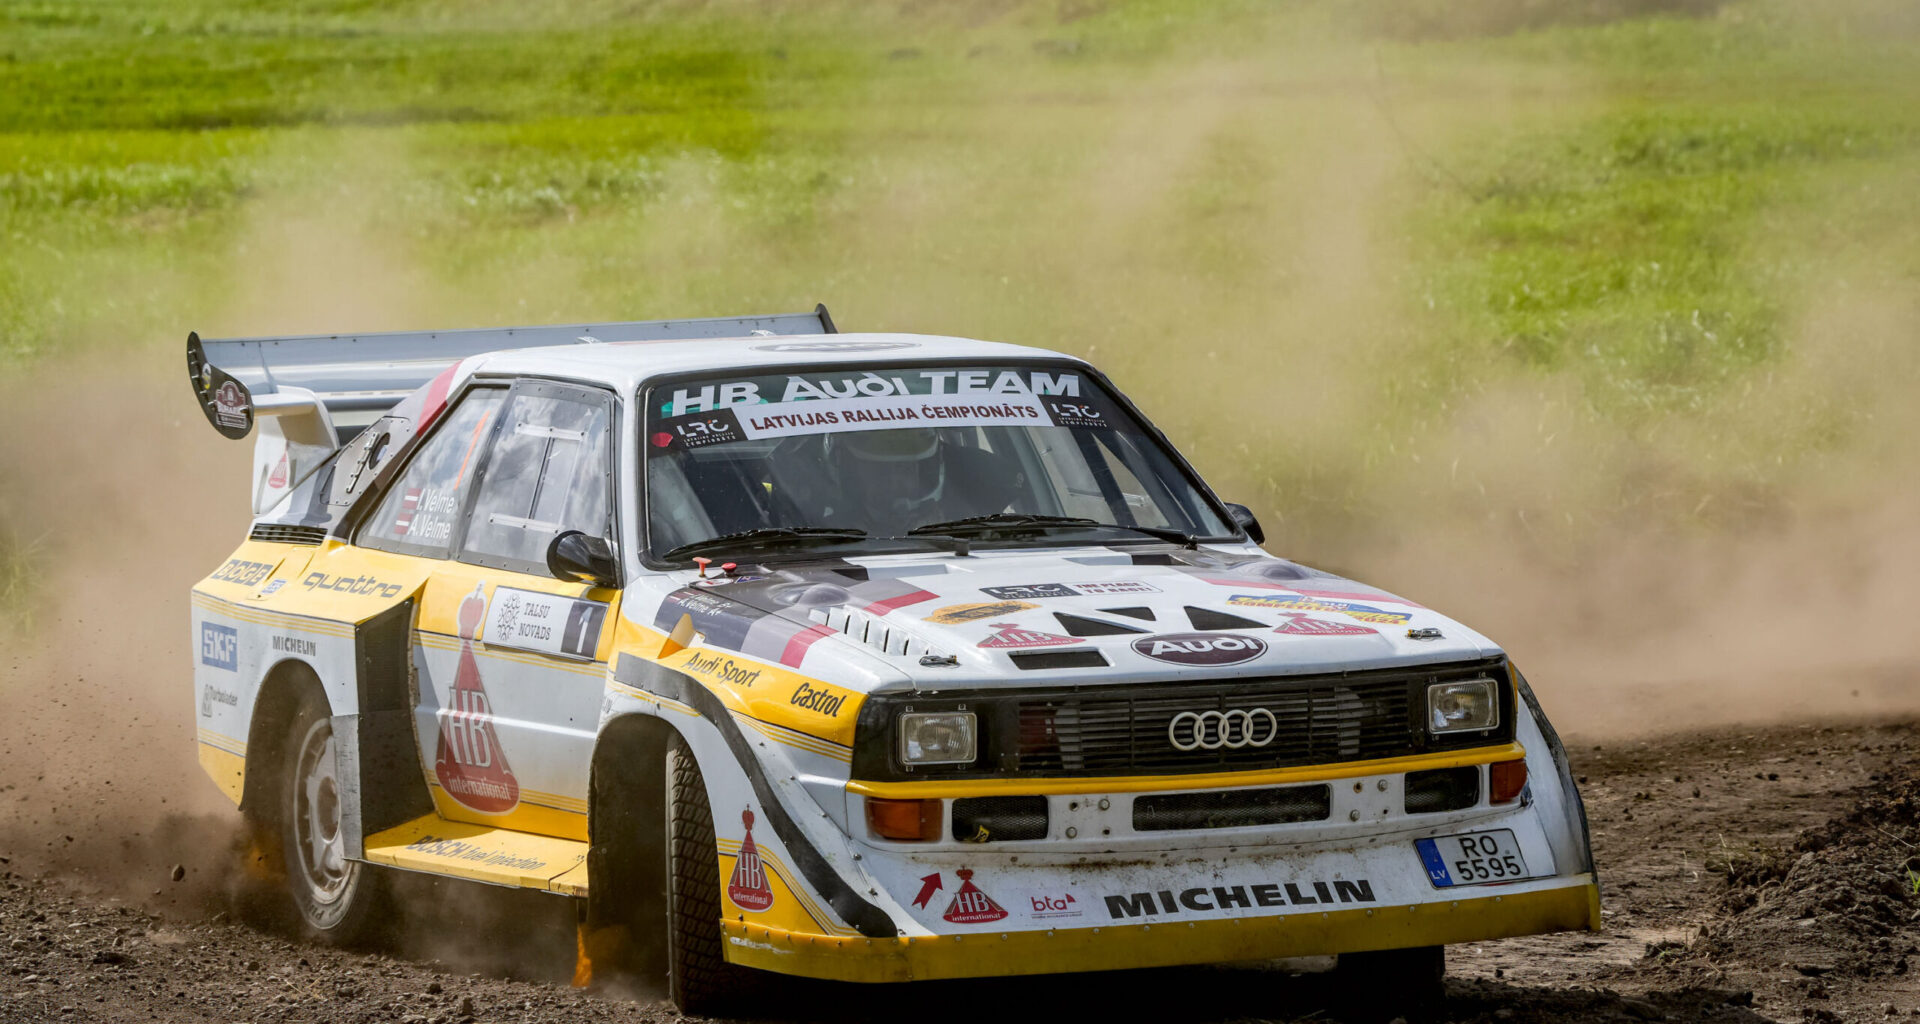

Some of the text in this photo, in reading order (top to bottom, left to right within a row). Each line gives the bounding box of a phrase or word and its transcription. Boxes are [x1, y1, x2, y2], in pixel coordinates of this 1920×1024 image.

[672, 381, 761, 416] HB
[919, 370, 1080, 397] TEAM
[750, 403, 1039, 431] LATVIJAS RALLIJA ČEMPIONĀTS
[303, 572, 403, 598] quattro
[523, 602, 551, 619] TALSU
[518, 622, 551, 641] NOVADS
[576, 606, 594, 654] 1
[998, 631, 1052, 643] HB
[203, 629, 237, 664] SKF
[272, 635, 316, 657] MICHELIN
[681, 652, 761, 687] Audi Sport
[790, 682, 848, 718] Castrol
[449, 686, 492, 768] HB
[446, 772, 512, 800] international
[405, 835, 472, 857] BOSCH
[459, 846, 498, 864] fuel
[1458, 835, 1498, 858] RO
[738, 851, 762, 890] HB
[1431, 869, 1446, 880] LV
[1455, 855, 1521, 881] 5595
[734, 892, 768, 906] international
[954, 891, 990, 913] HB
[1031, 895, 1067, 912] bta
[1104, 880, 1376, 919] MICHELIN
[952, 912, 1002, 922] international
